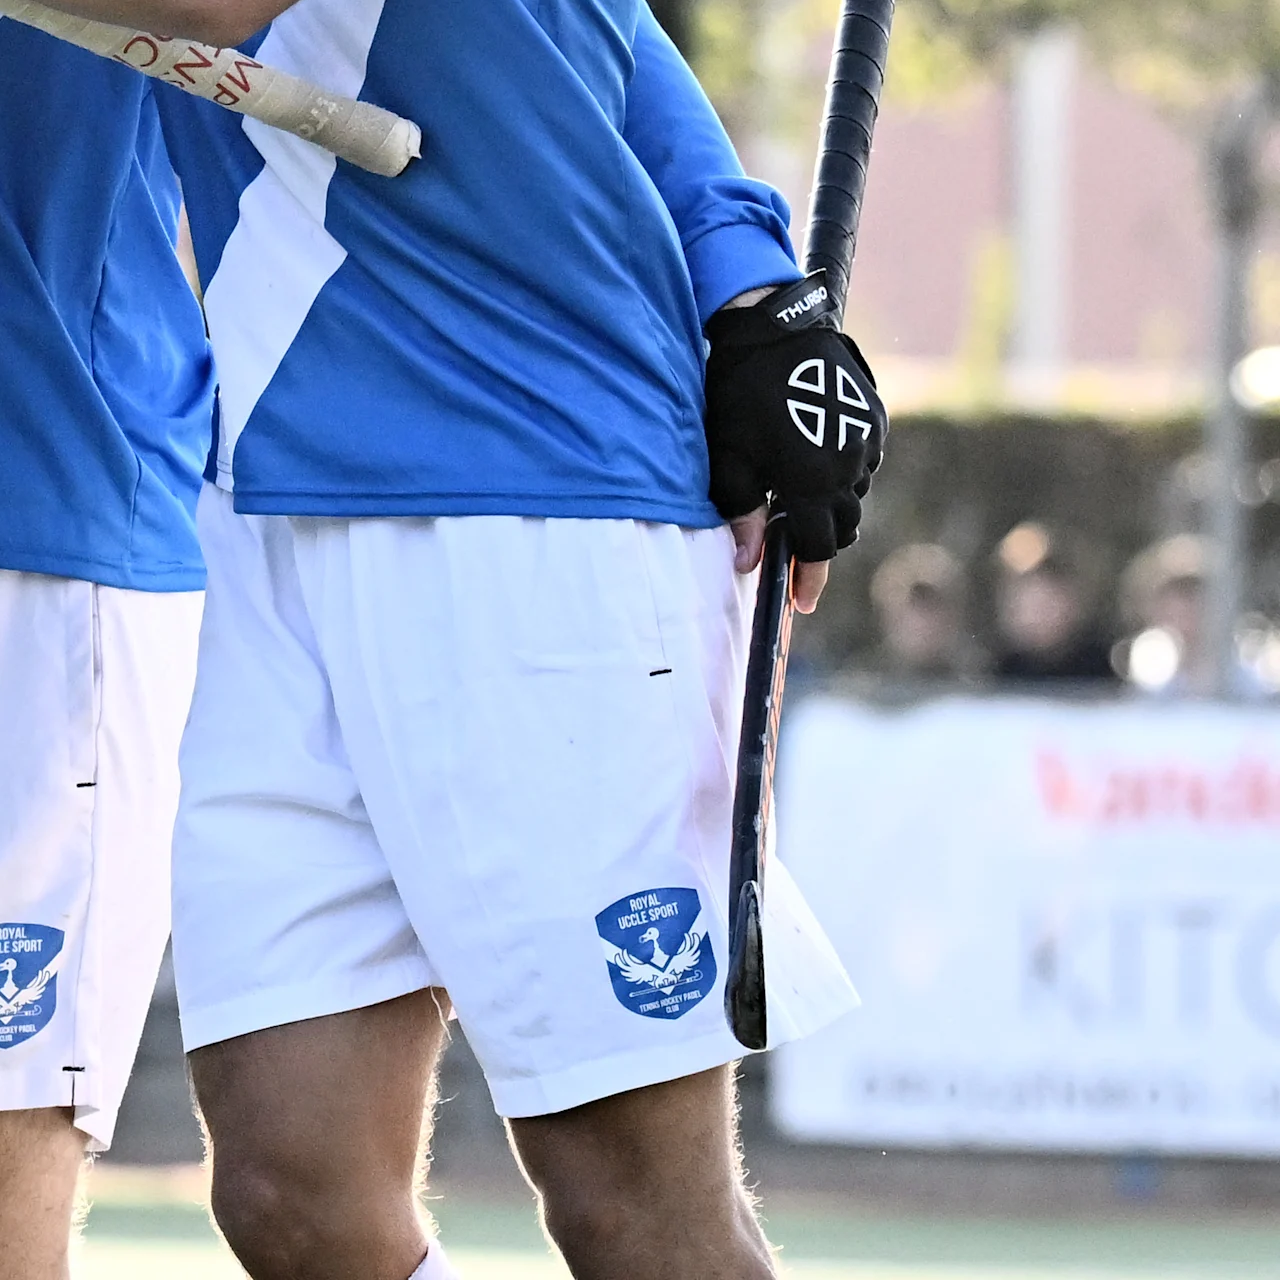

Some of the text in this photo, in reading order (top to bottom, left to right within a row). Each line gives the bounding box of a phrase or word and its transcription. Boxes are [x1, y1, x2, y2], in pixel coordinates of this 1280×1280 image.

[776, 285, 829, 324] THURSO
[629, 892, 662, 913] ROYAL
[617, 902, 680, 930] UCCLE SPORT
[11, 939, 44, 953] SPORT
[665, 1004, 680, 1014] CLUB
